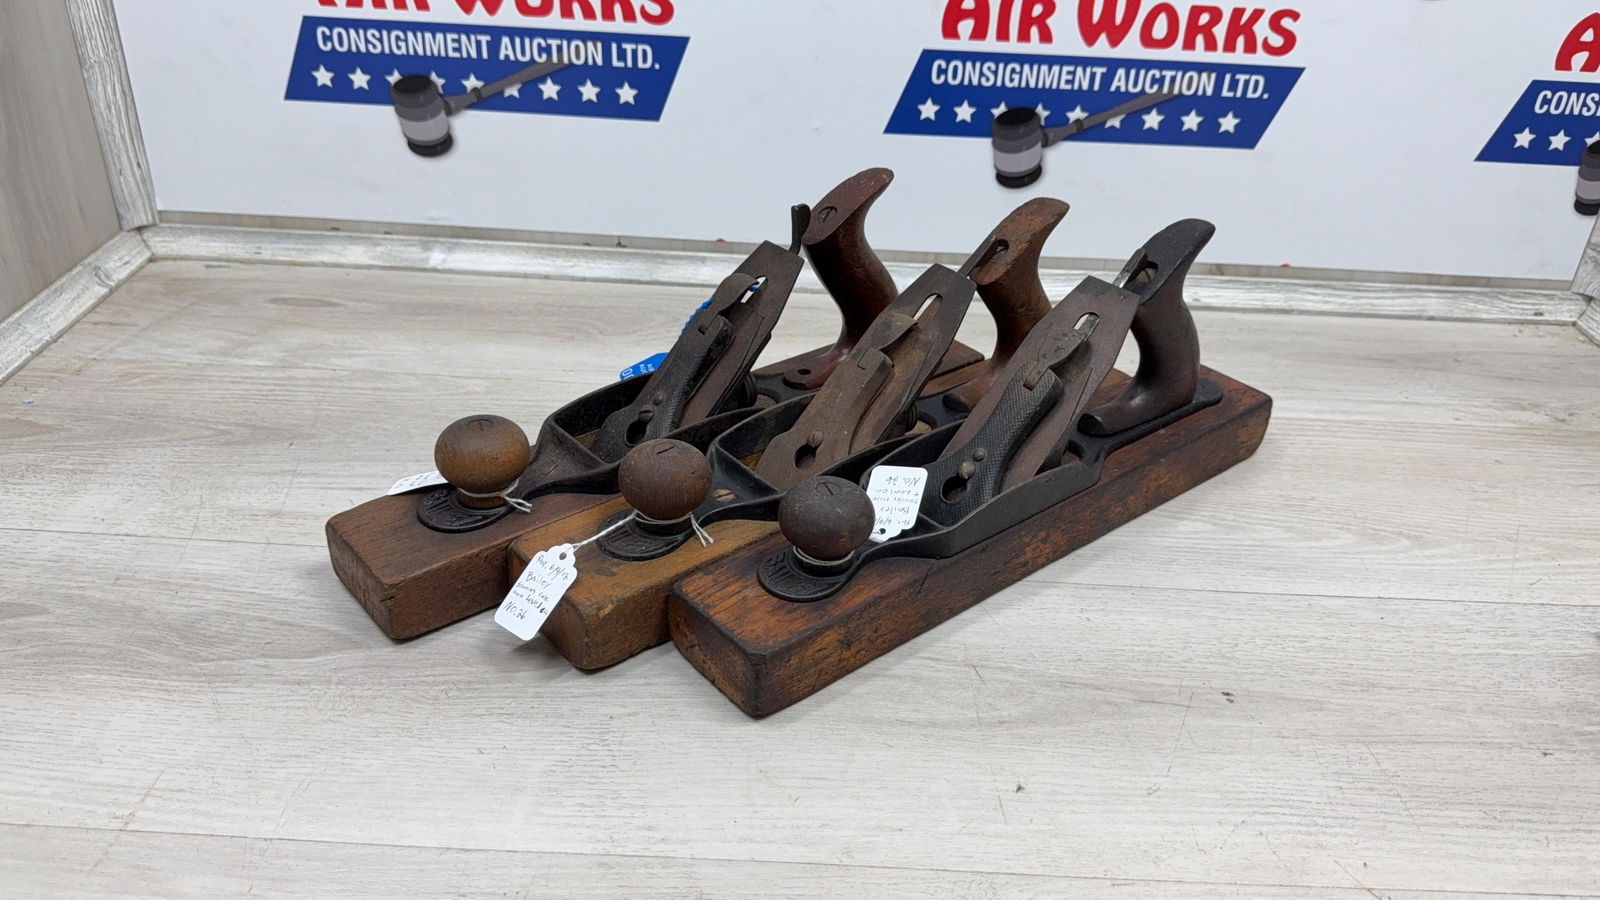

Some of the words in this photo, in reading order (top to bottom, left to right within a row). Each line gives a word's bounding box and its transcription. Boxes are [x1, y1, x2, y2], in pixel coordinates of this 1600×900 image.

[315, 26, 491, 60] CONSIGNMENT
[499, 34, 603, 66] AUCTION
[611, 41, 660, 70] LTD.
[941, 0, 1057, 44] AIR
[1076, 0, 1301, 57] WORKS
[931, 58, 1107, 92] CONSIGNMENT
[1110, 67, 1217, 97] AUCTION
[1220, 73, 1270, 100] LTD.
[1534, 90, 1600, 117] CONS
